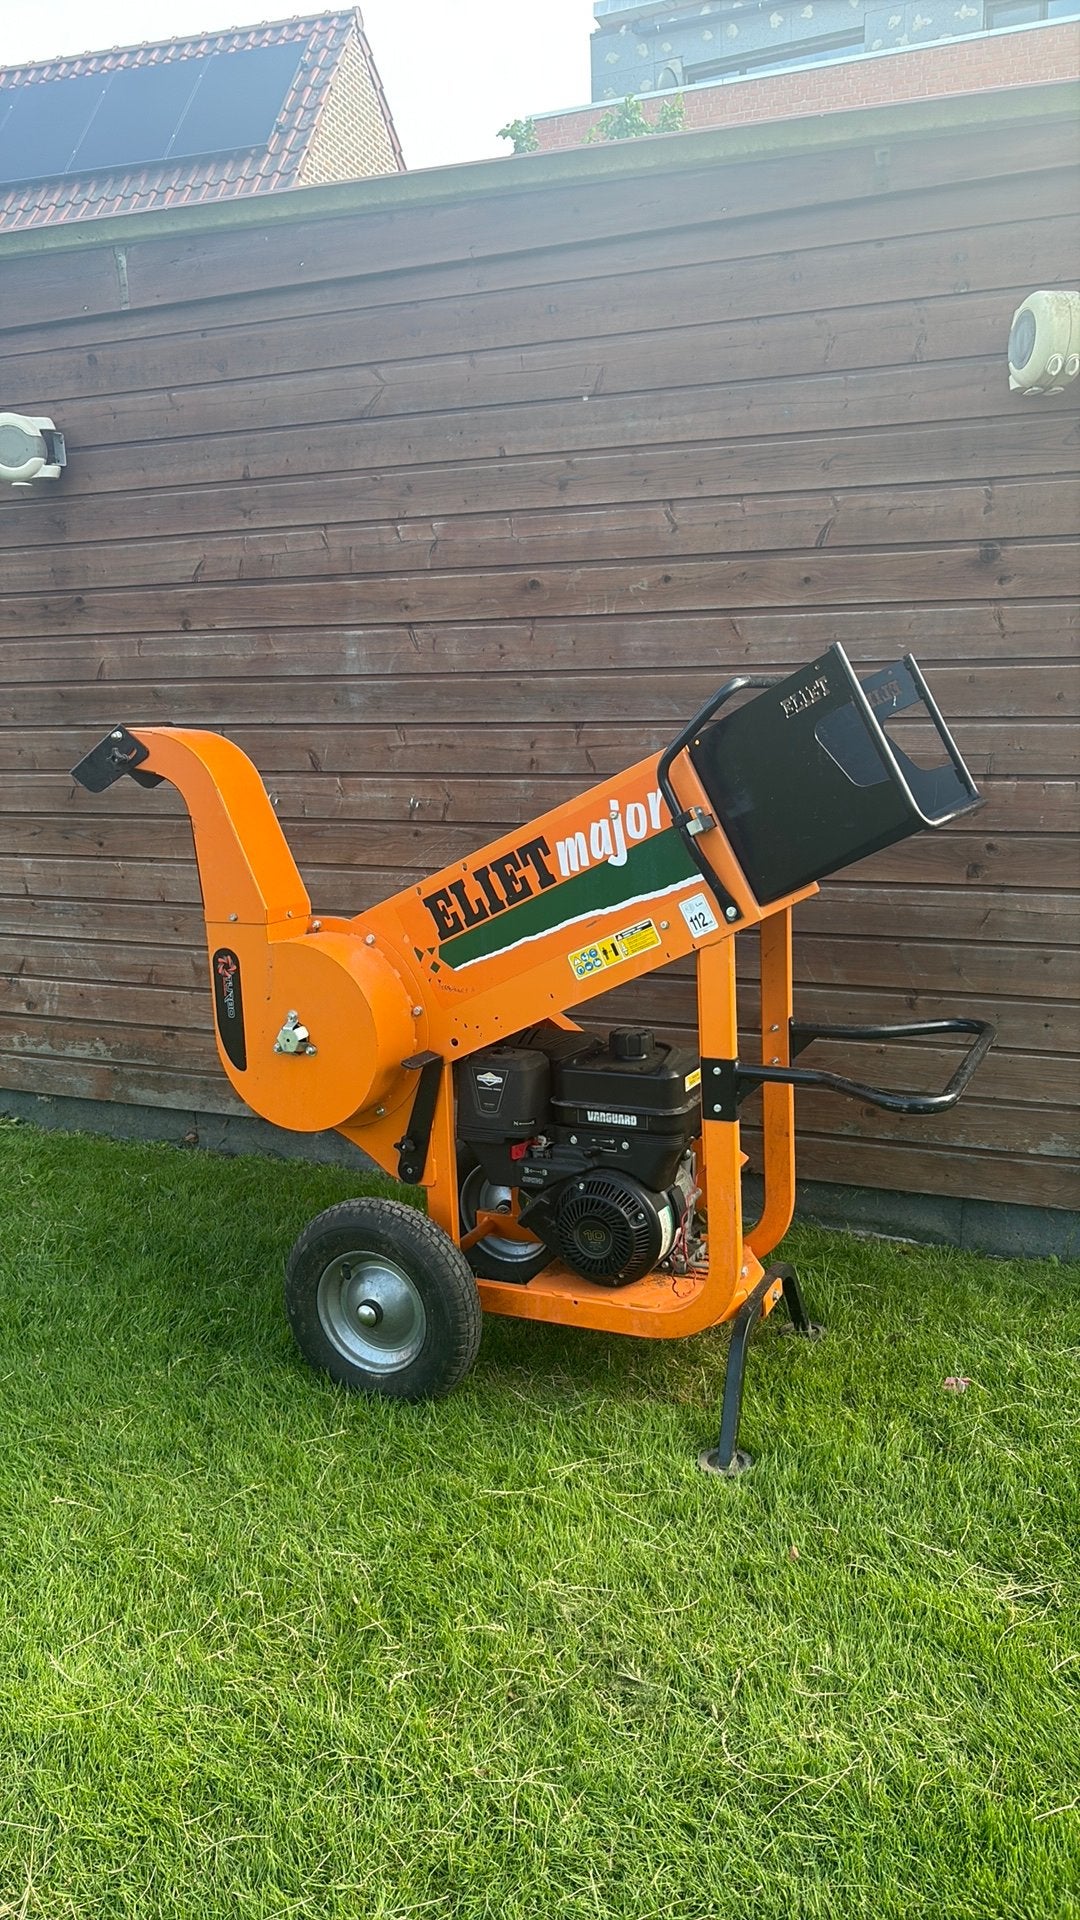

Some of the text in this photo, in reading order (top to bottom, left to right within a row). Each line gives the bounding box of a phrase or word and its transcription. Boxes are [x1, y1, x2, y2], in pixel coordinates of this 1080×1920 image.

[779, 675, 830, 719] ELIET
[422, 788, 662, 941] ELIET major
[689, 912, 708, 931] 112
[587, 1111, 638, 1126] VANGUARD
[582, 1229, 606, 1243] 10
